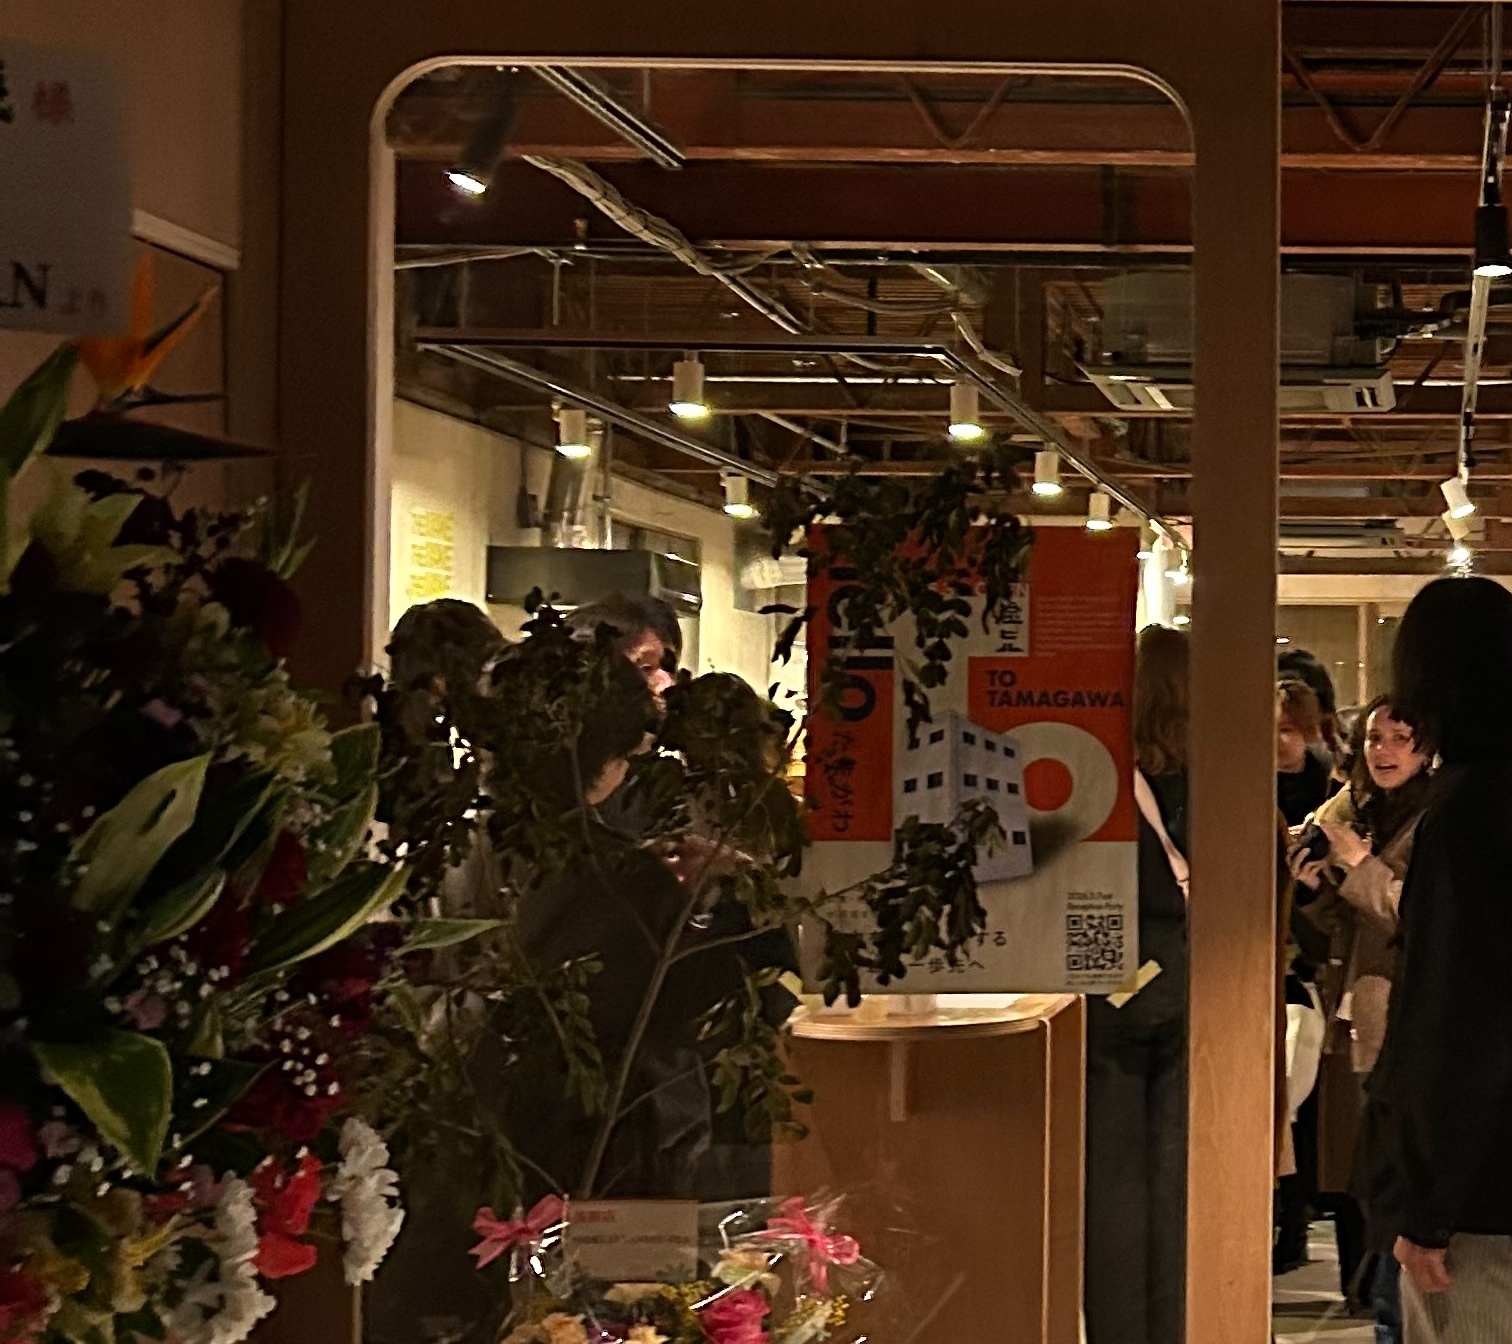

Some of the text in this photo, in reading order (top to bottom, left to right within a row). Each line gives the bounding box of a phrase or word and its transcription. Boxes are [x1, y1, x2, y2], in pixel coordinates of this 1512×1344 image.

[0, 260, 51, 311] N
[986, 669, 1017, 688] TO
[987, 689, 1126, 708] TAMAGAWA
